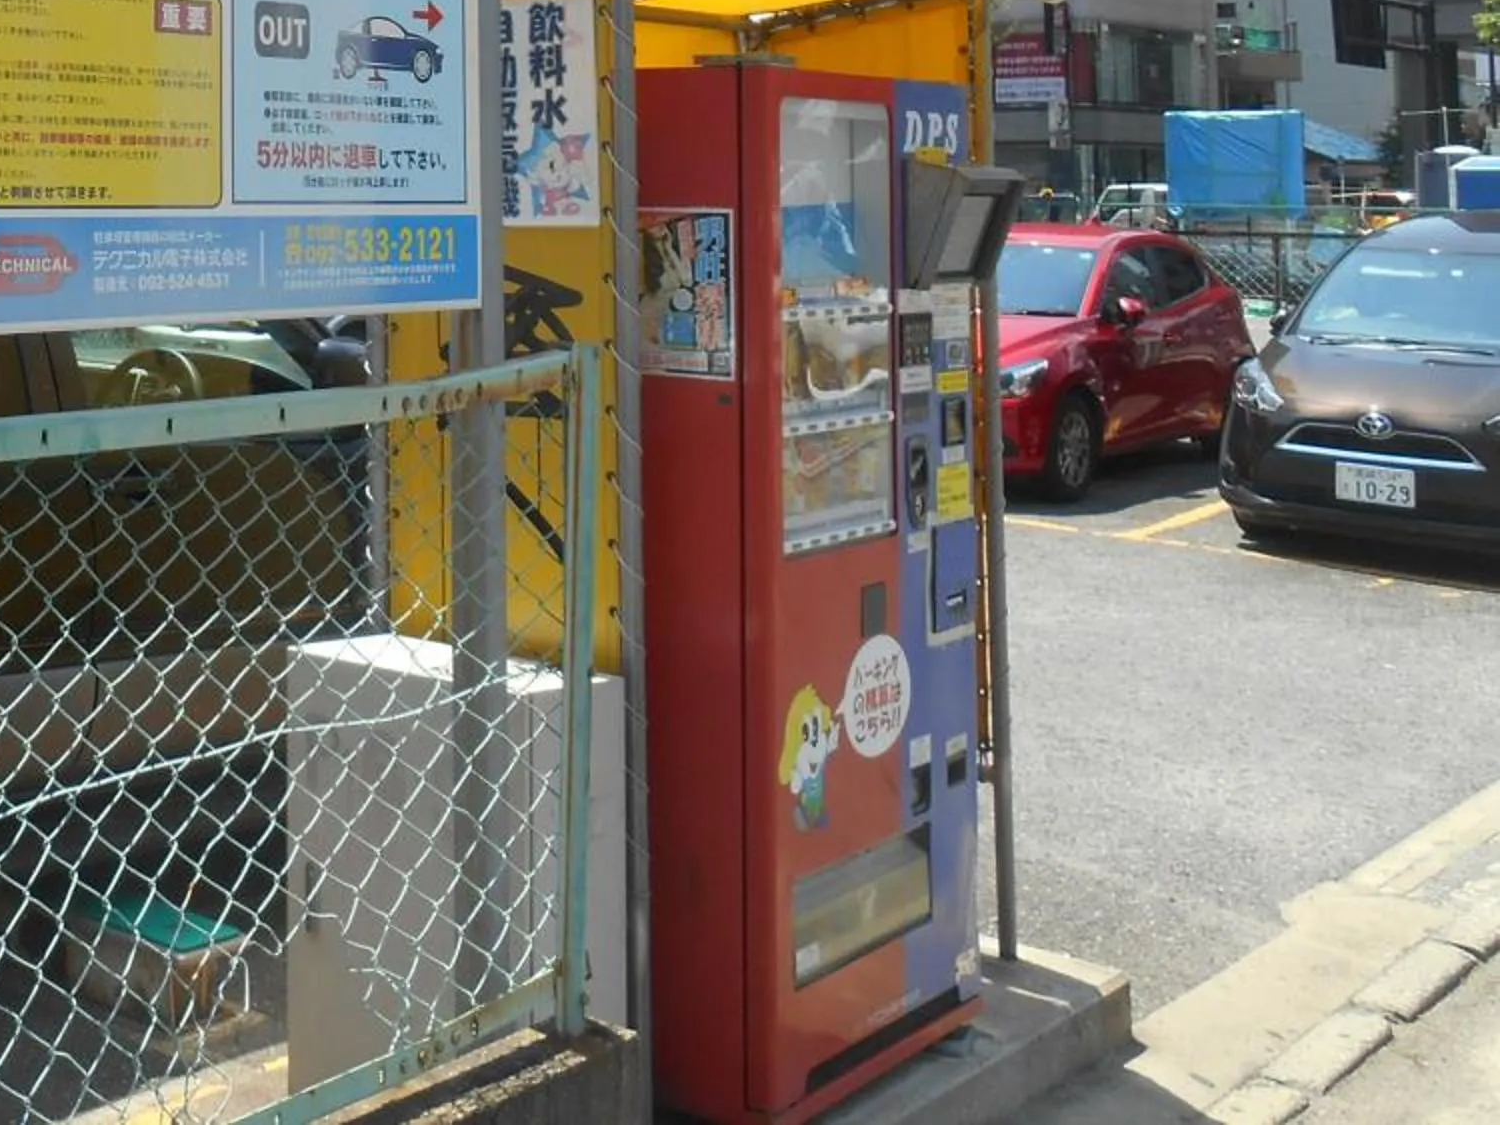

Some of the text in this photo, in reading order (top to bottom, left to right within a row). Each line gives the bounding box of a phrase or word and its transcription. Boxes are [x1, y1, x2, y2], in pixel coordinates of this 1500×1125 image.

[161, 2, 207, 31] 重要
[259, 14, 307, 49] OUT
[527, 0, 568, 129] 飲料水
[903, 110, 959, 155] DPS
